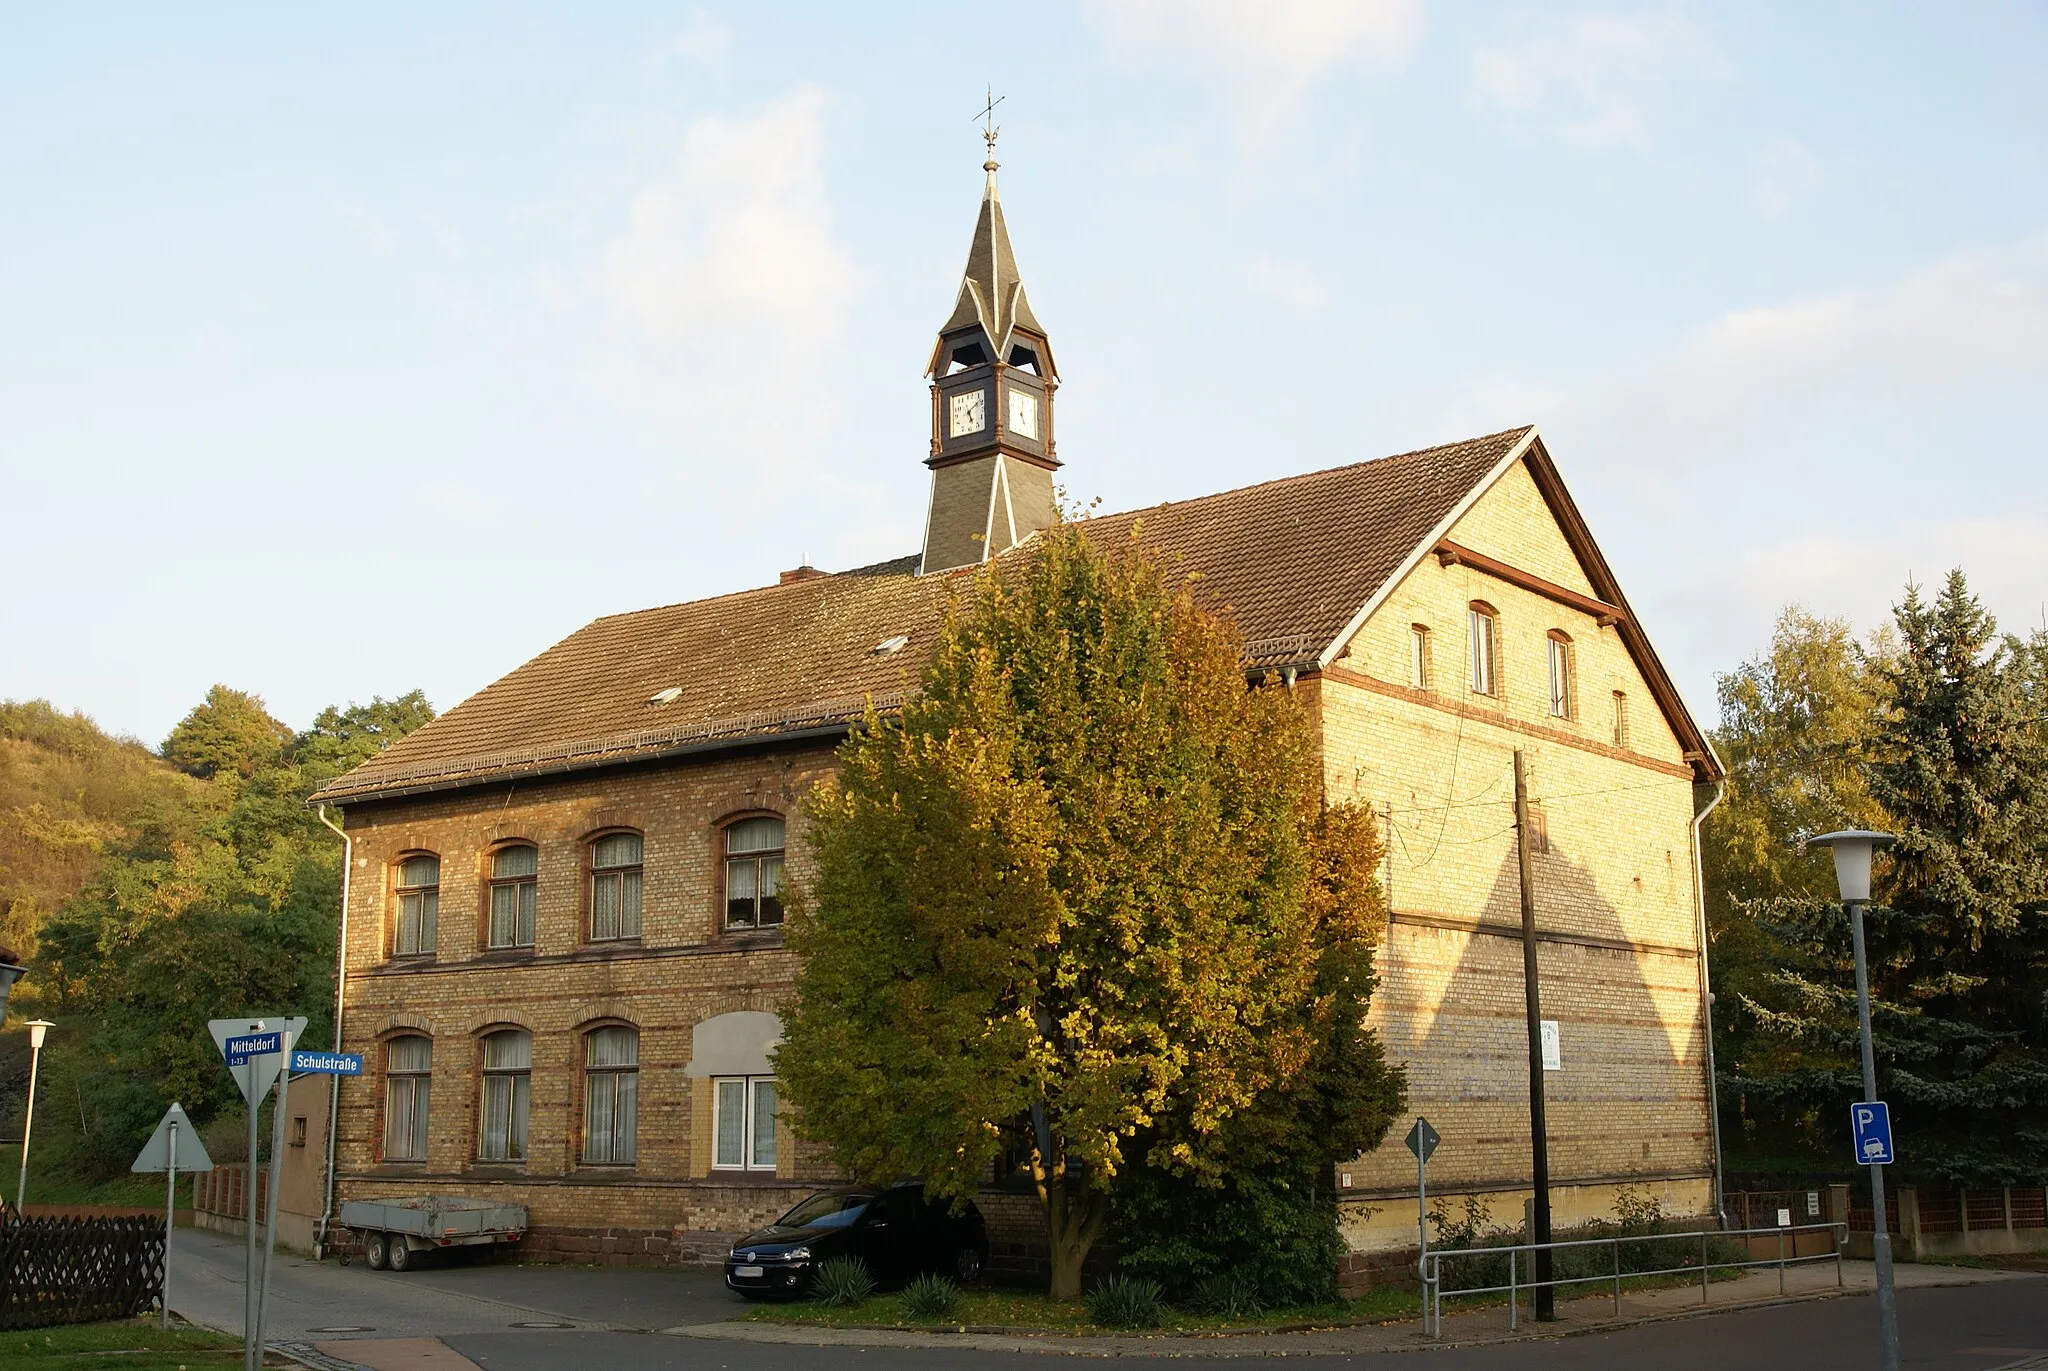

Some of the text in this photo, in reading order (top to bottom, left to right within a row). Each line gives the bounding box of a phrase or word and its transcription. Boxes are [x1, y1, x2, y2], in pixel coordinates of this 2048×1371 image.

[231, 1037, 276, 1054] Mitteldorf
[231, 1057, 243, 1066] 1-13
[296, 1054, 357, 1071] Schulstraße
[1857, 1108, 1874, 1135] P
